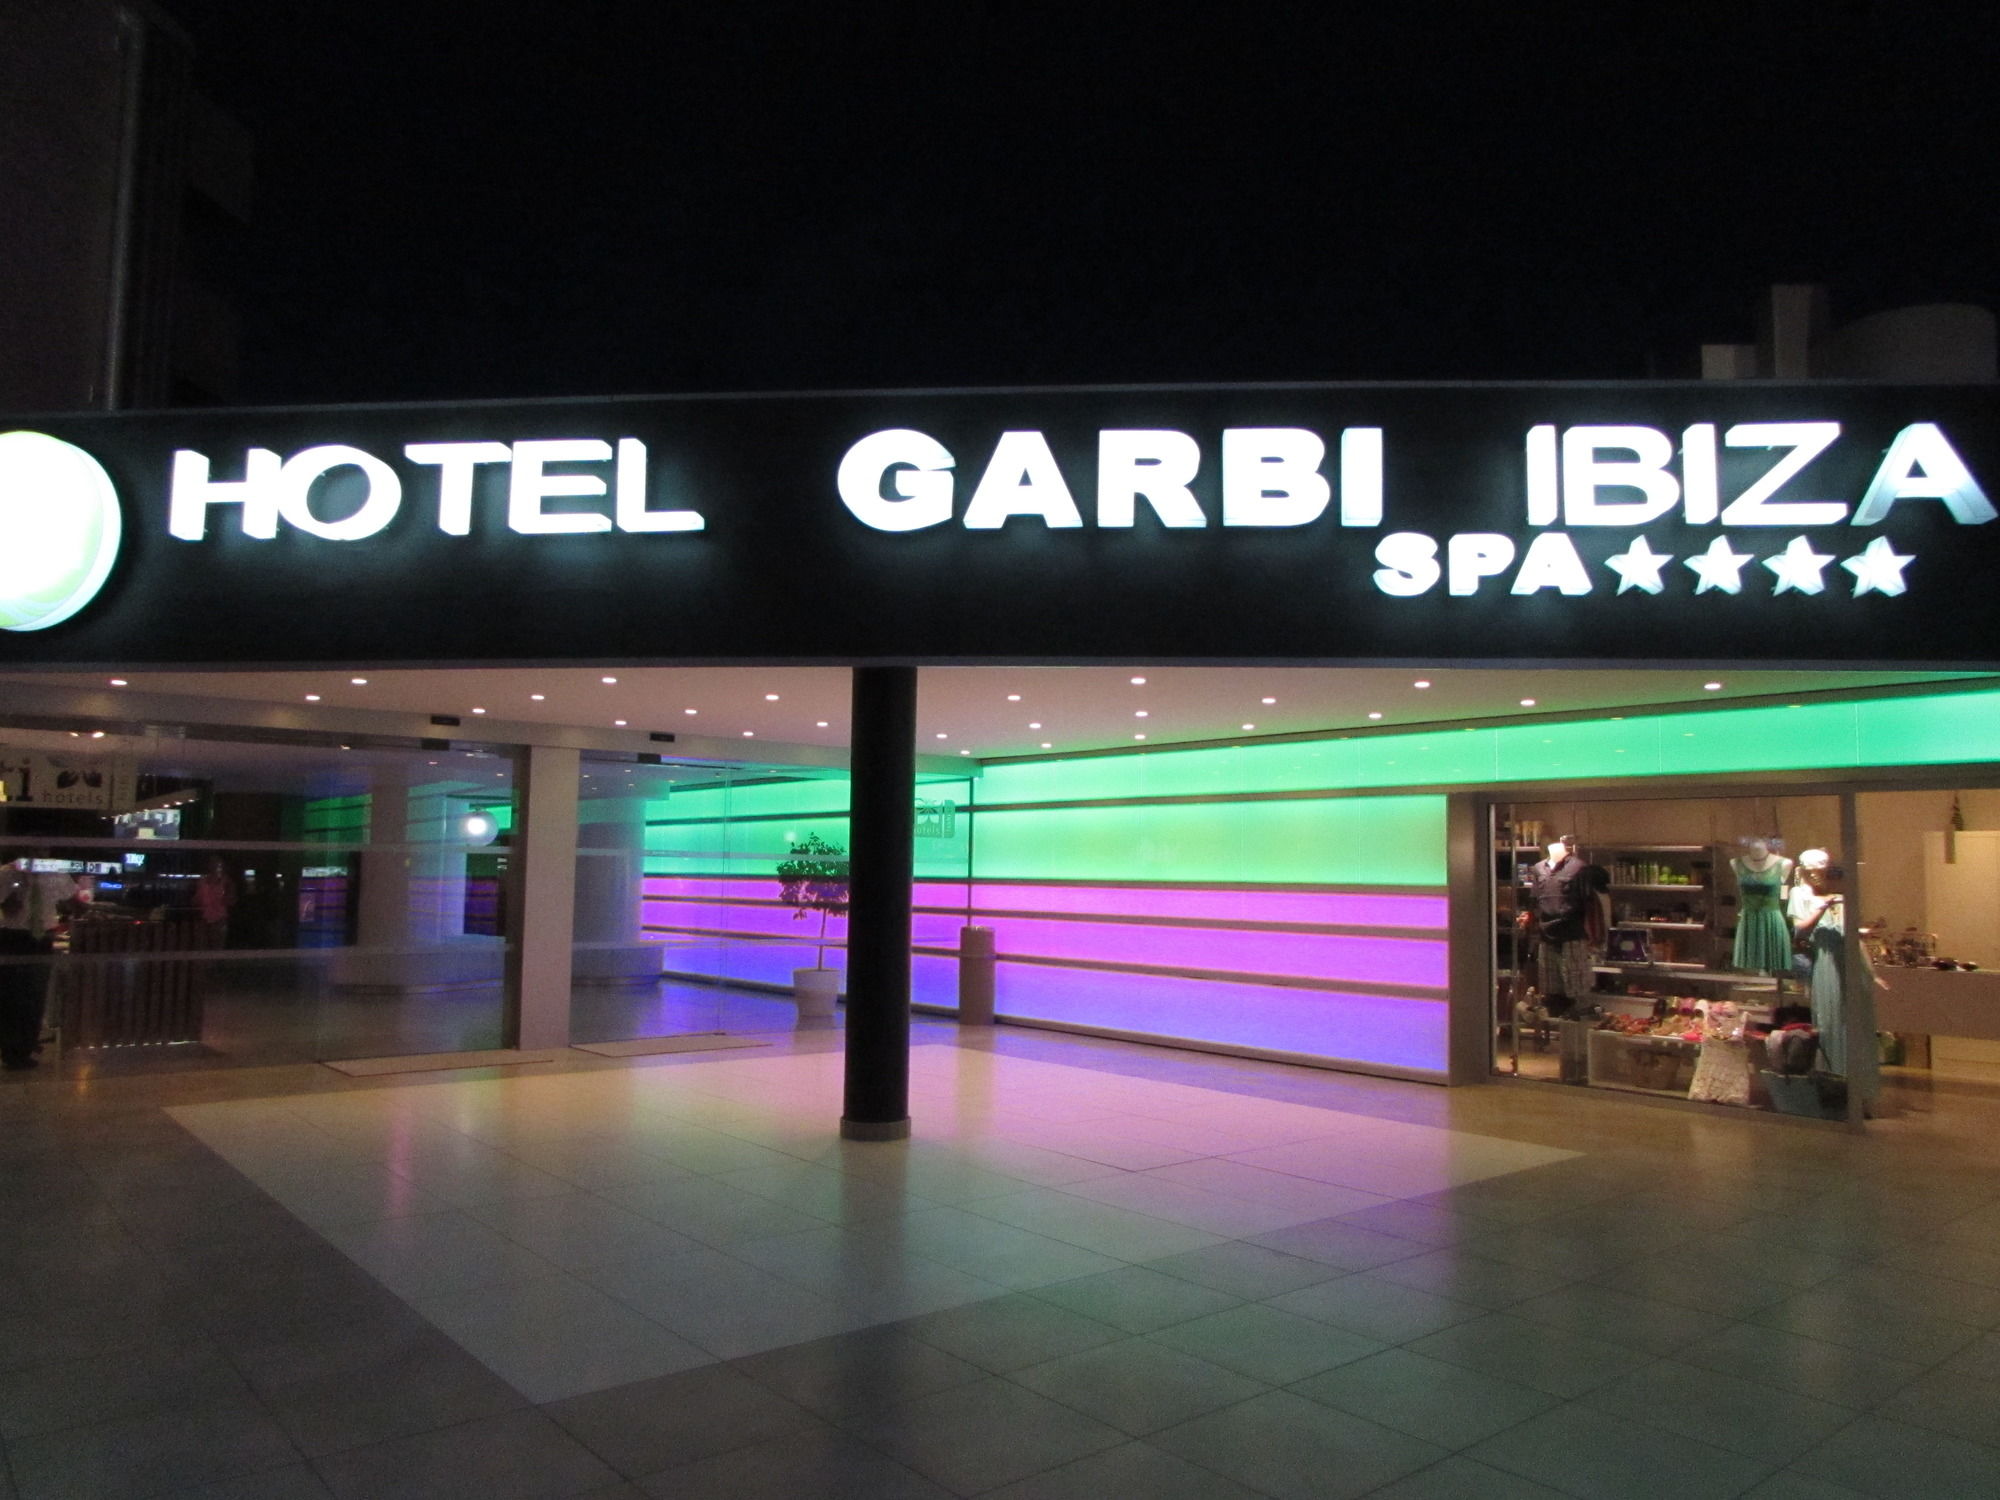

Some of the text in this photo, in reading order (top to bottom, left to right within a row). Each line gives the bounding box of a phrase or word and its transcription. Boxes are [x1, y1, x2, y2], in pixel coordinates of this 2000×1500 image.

[168, 421, 1998, 541] HOTEL GARBI IBIZA
[1372, 531, 1593, 597] SPA
